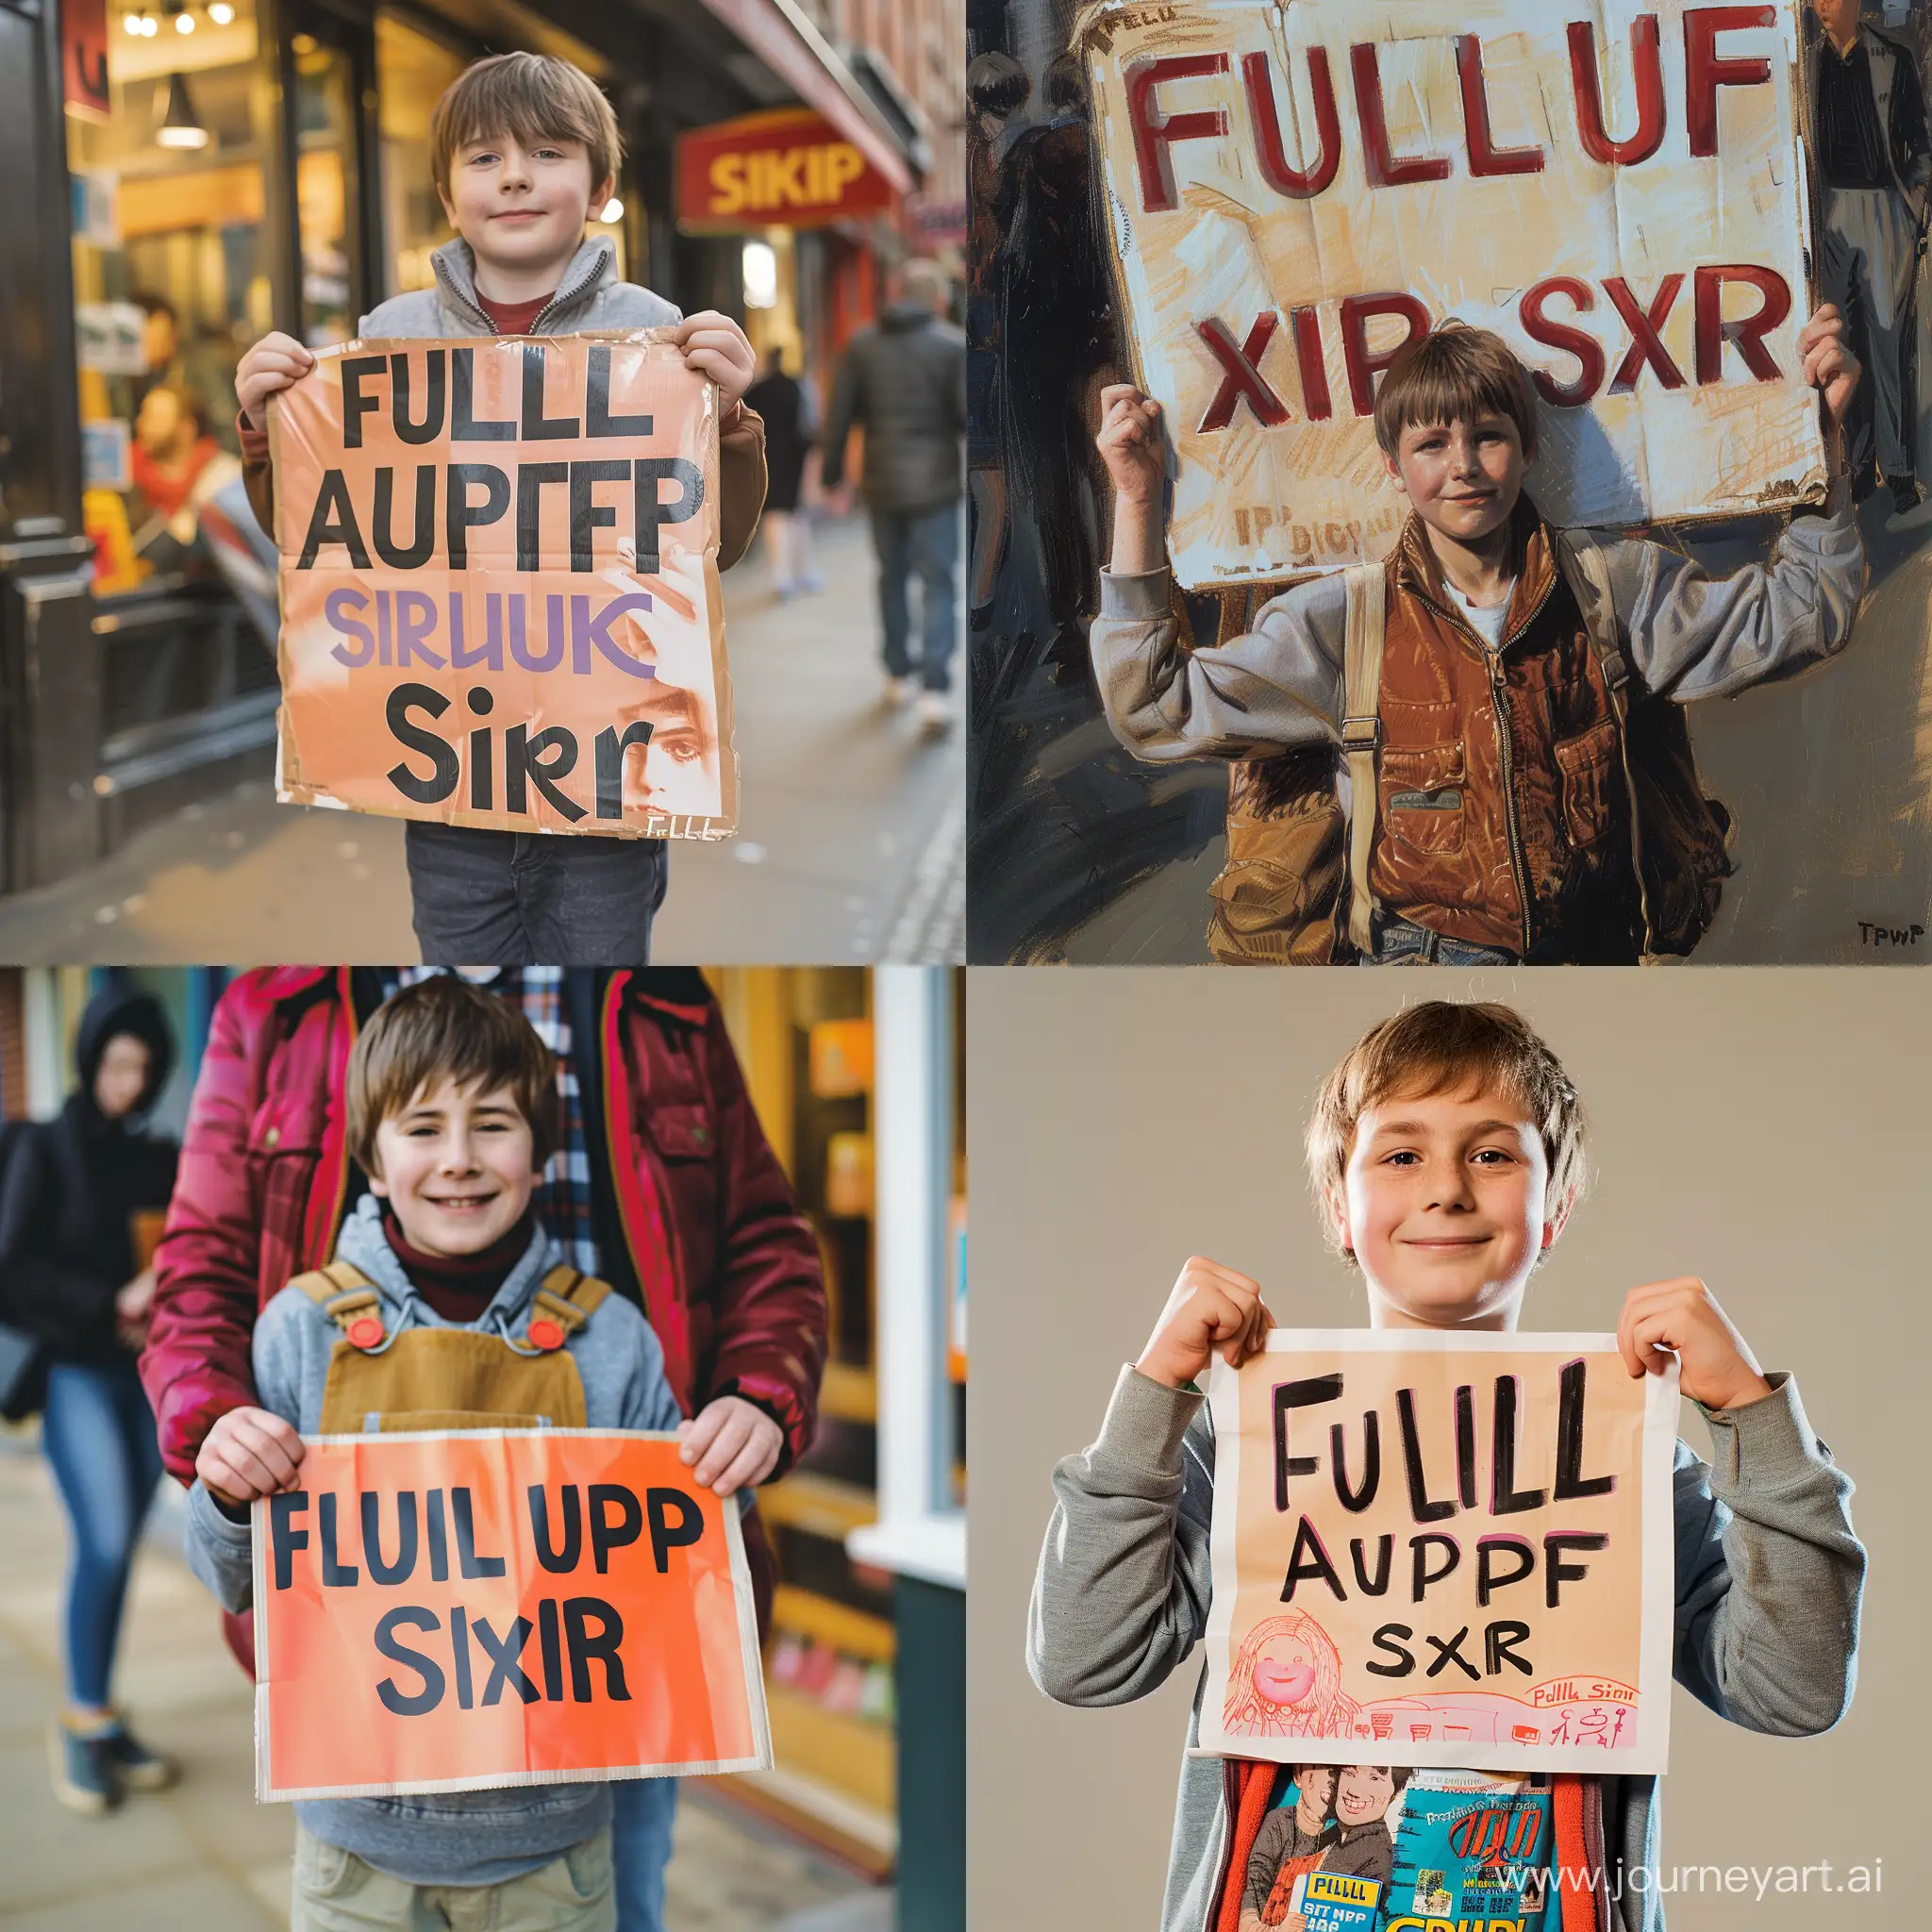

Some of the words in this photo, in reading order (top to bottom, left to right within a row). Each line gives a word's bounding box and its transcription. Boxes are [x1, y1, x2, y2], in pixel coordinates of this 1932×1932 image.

[710, 142, 865, 215] SIKIP
[1519, 263, 1792, 408] SXR
[340, 345, 655, 449] FULLL
[270, 1487, 507, 1591] FLUIL
[527, 1483, 705, 1575] UPP
[1278, 1513, 1610, 1608] AUPPF
[374, 1596, 633, 1717] SIXIR
[1365, 1619, 1534, 1682] SXR
